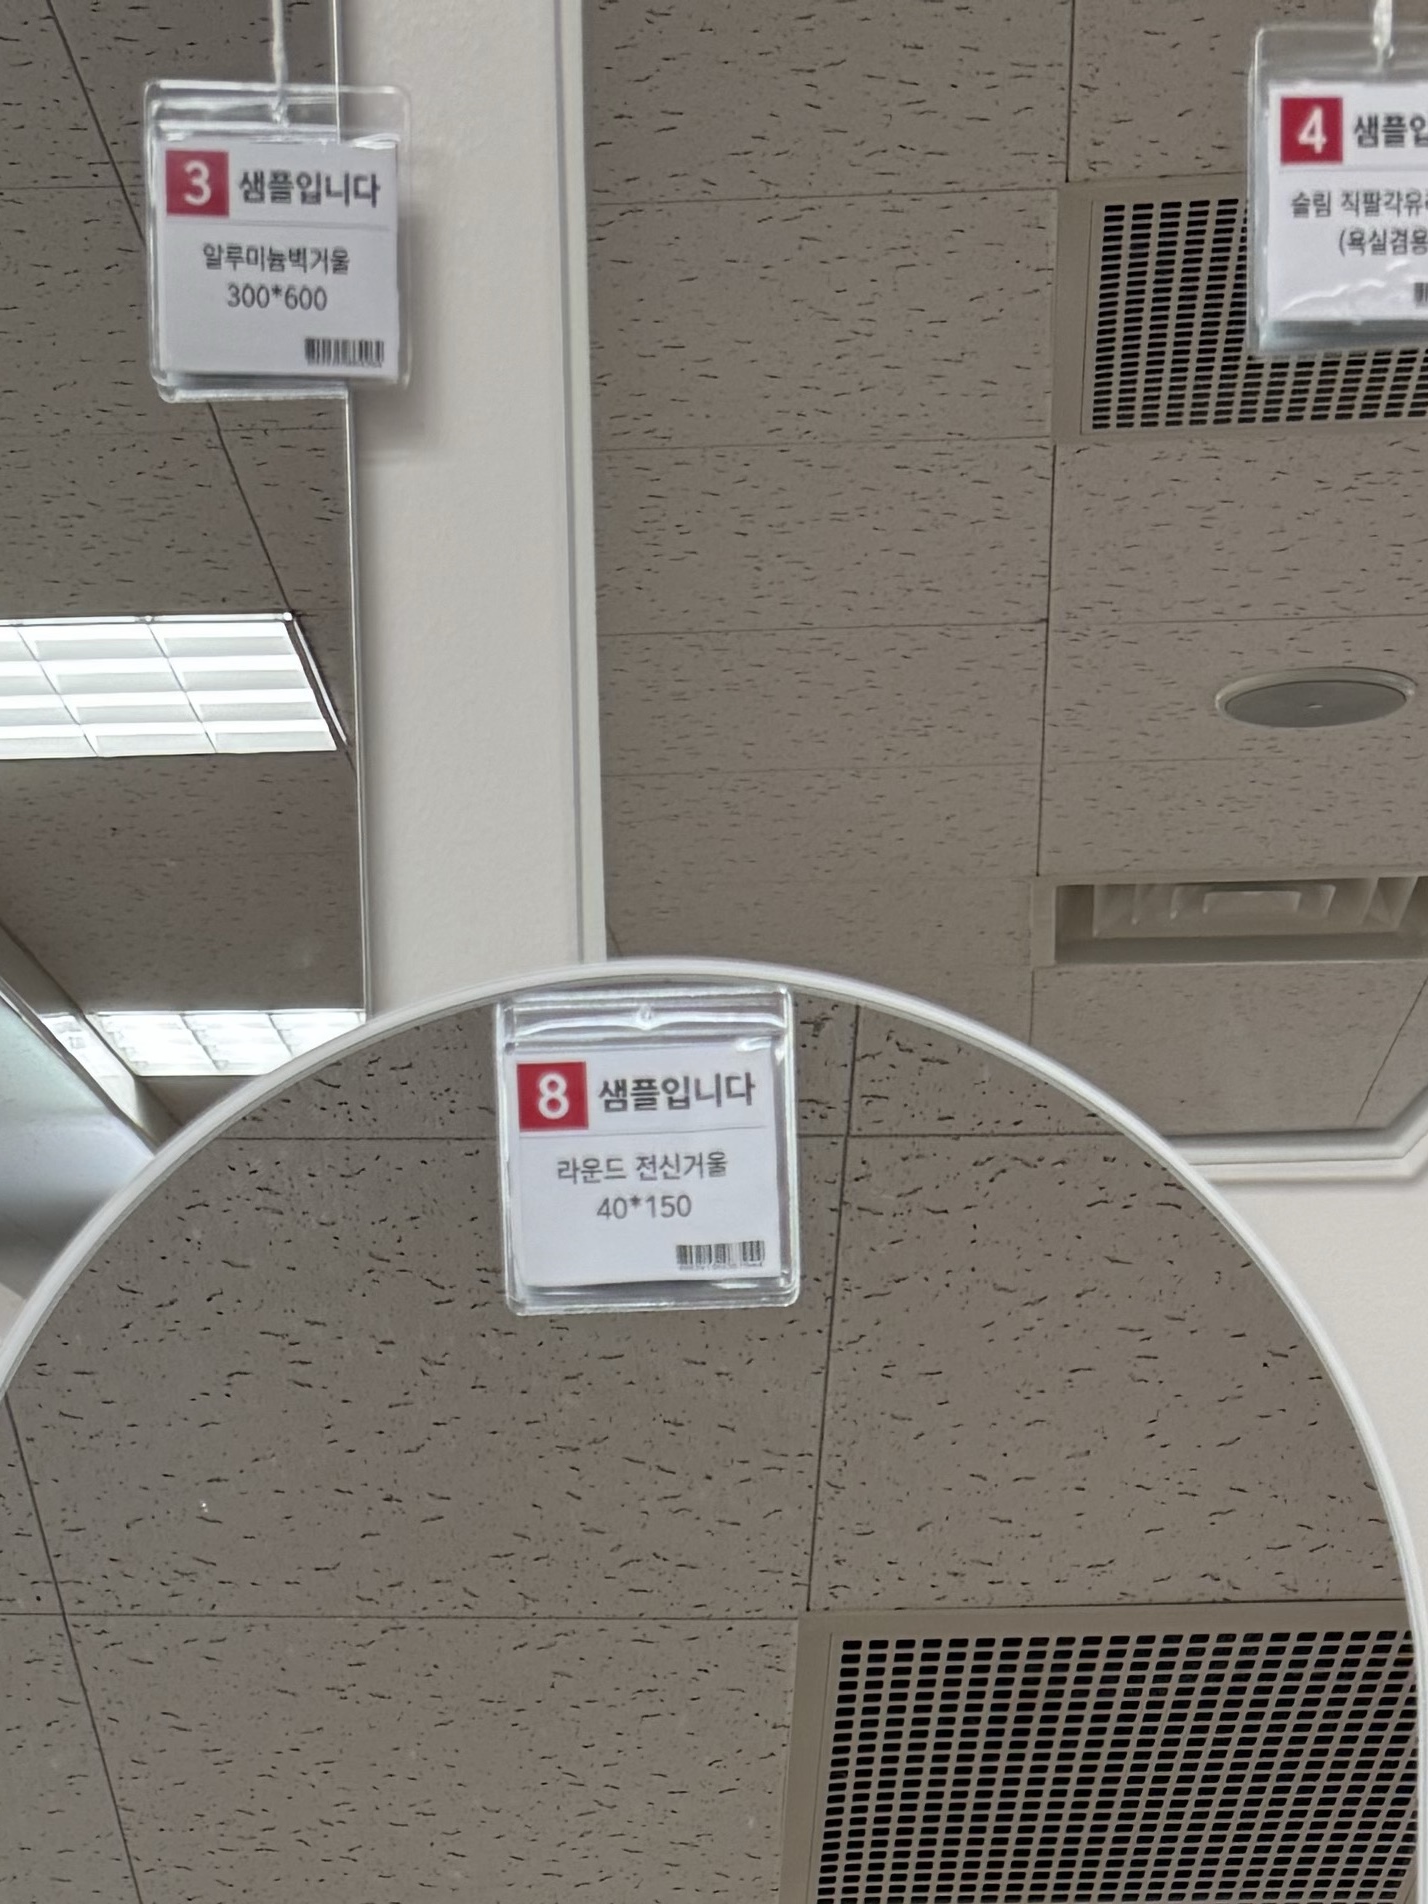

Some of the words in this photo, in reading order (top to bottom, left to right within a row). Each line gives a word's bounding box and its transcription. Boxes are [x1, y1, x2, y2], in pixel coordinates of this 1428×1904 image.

[1297, 105, 1328, 154] 4
[183, 159, 213, 207] 3
[238, 168, 381, 208] 샘플입니다
[1290, 190, 1332, 219] 슬림
[202, 242, 350, 276] 알루미늄벽거울
[536, 1071, 570, 1121] 8
[597, 1071, 757, 1114] 샘플입니다
[556, 1157, 628, 1185] 라운드
[635, 1150, 729, 1183] 전신거울
